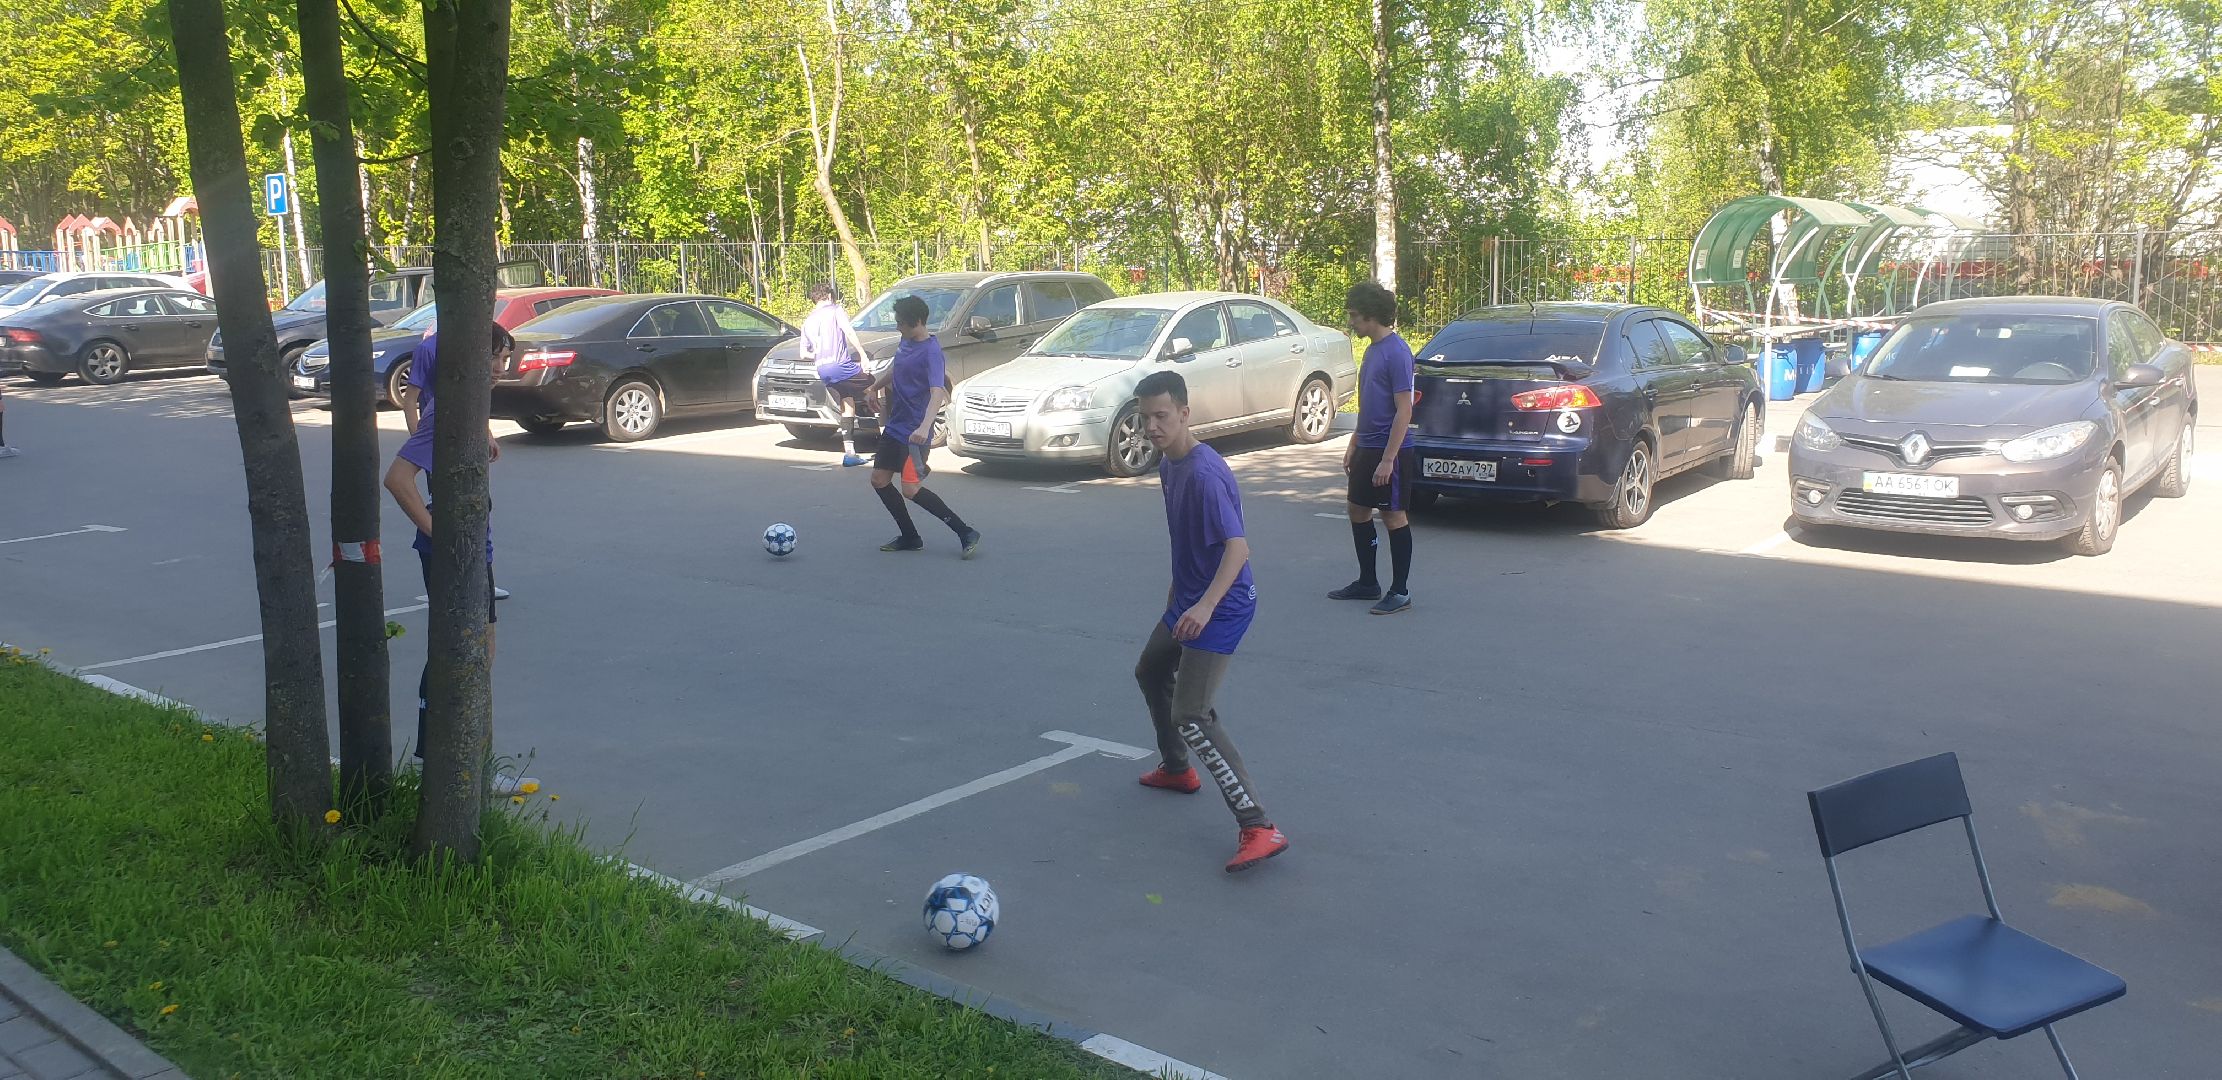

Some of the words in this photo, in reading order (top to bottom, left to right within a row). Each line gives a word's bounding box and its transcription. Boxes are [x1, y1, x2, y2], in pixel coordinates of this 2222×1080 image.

[269, 178, 283, 210] P
[1474, 462, 1493, 474] 797
[1875, 476, 1894, 488] AA
[1898, 477, 1929, 490] 6561
[1933, 479, 1954, 491] OK
[1177, 722, 1255, 811] ATHLETIC
